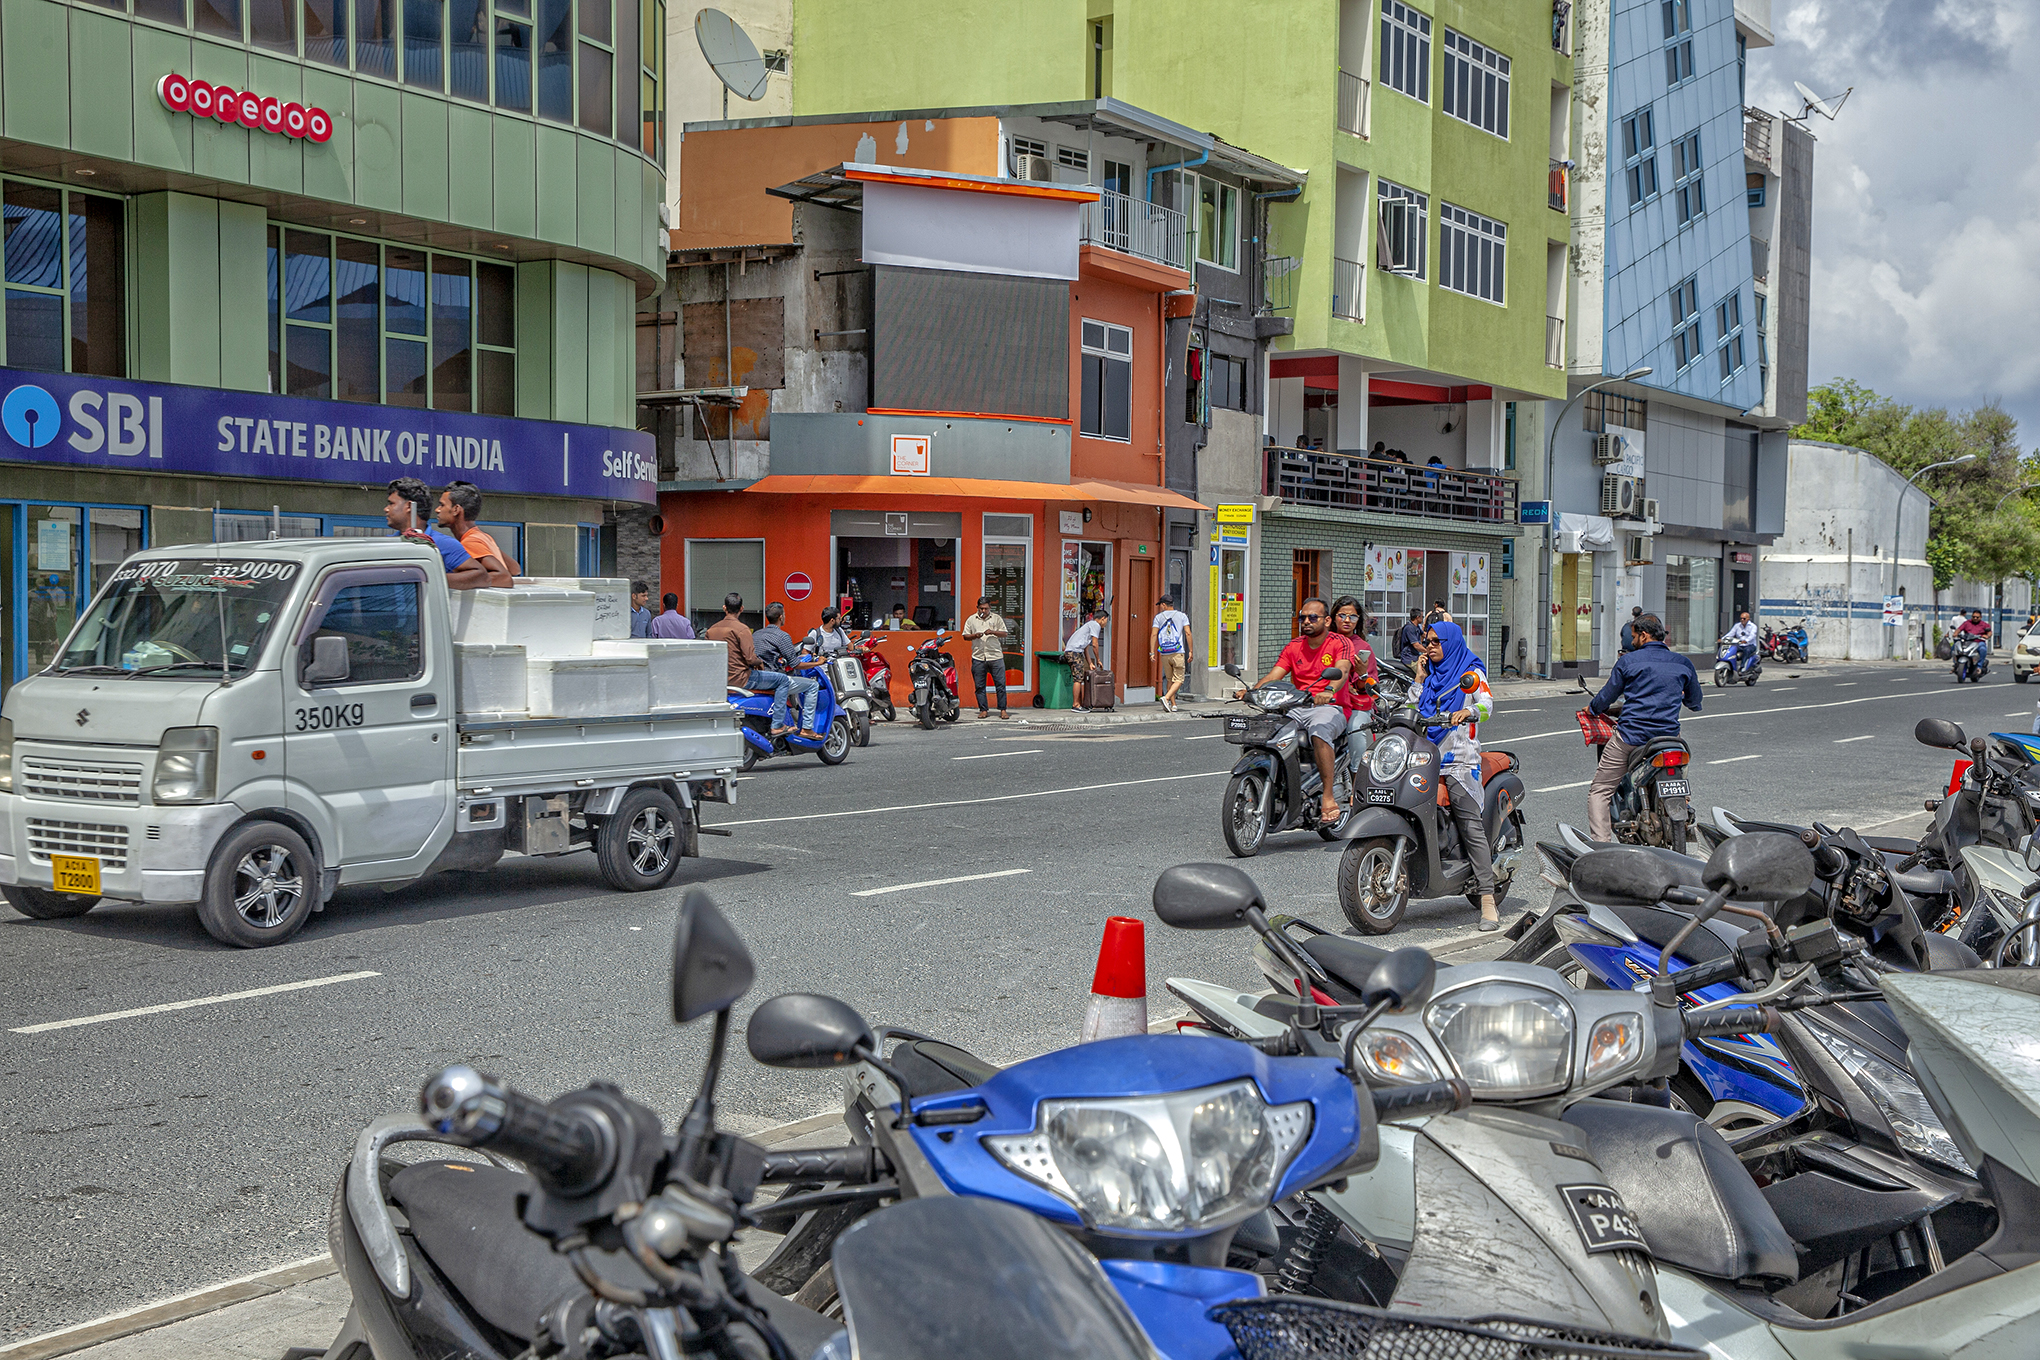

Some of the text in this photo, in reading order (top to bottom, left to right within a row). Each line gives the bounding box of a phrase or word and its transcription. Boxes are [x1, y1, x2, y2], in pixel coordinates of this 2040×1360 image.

[168, 80, 328, 136] ooredoo
[68, 390, 162, 458] SBI
[217, 416, 505, 472] STATE BANK OF INDIA
[602, 450, 632, 478] Self
[1627, 454, 1643, 466] PACIFIC
[1616, 465, 1633, 475] CARGO
[1522, 506, 1547, 515] REON
[152, 575, 213, 587] SUZUKI
[295, 703, 364, 731] 350Kg
[1663, 786, 1686, 795] P1911
[1370, 794, 1391, 803] C9275
[60, 872, 94, 888] T2800
